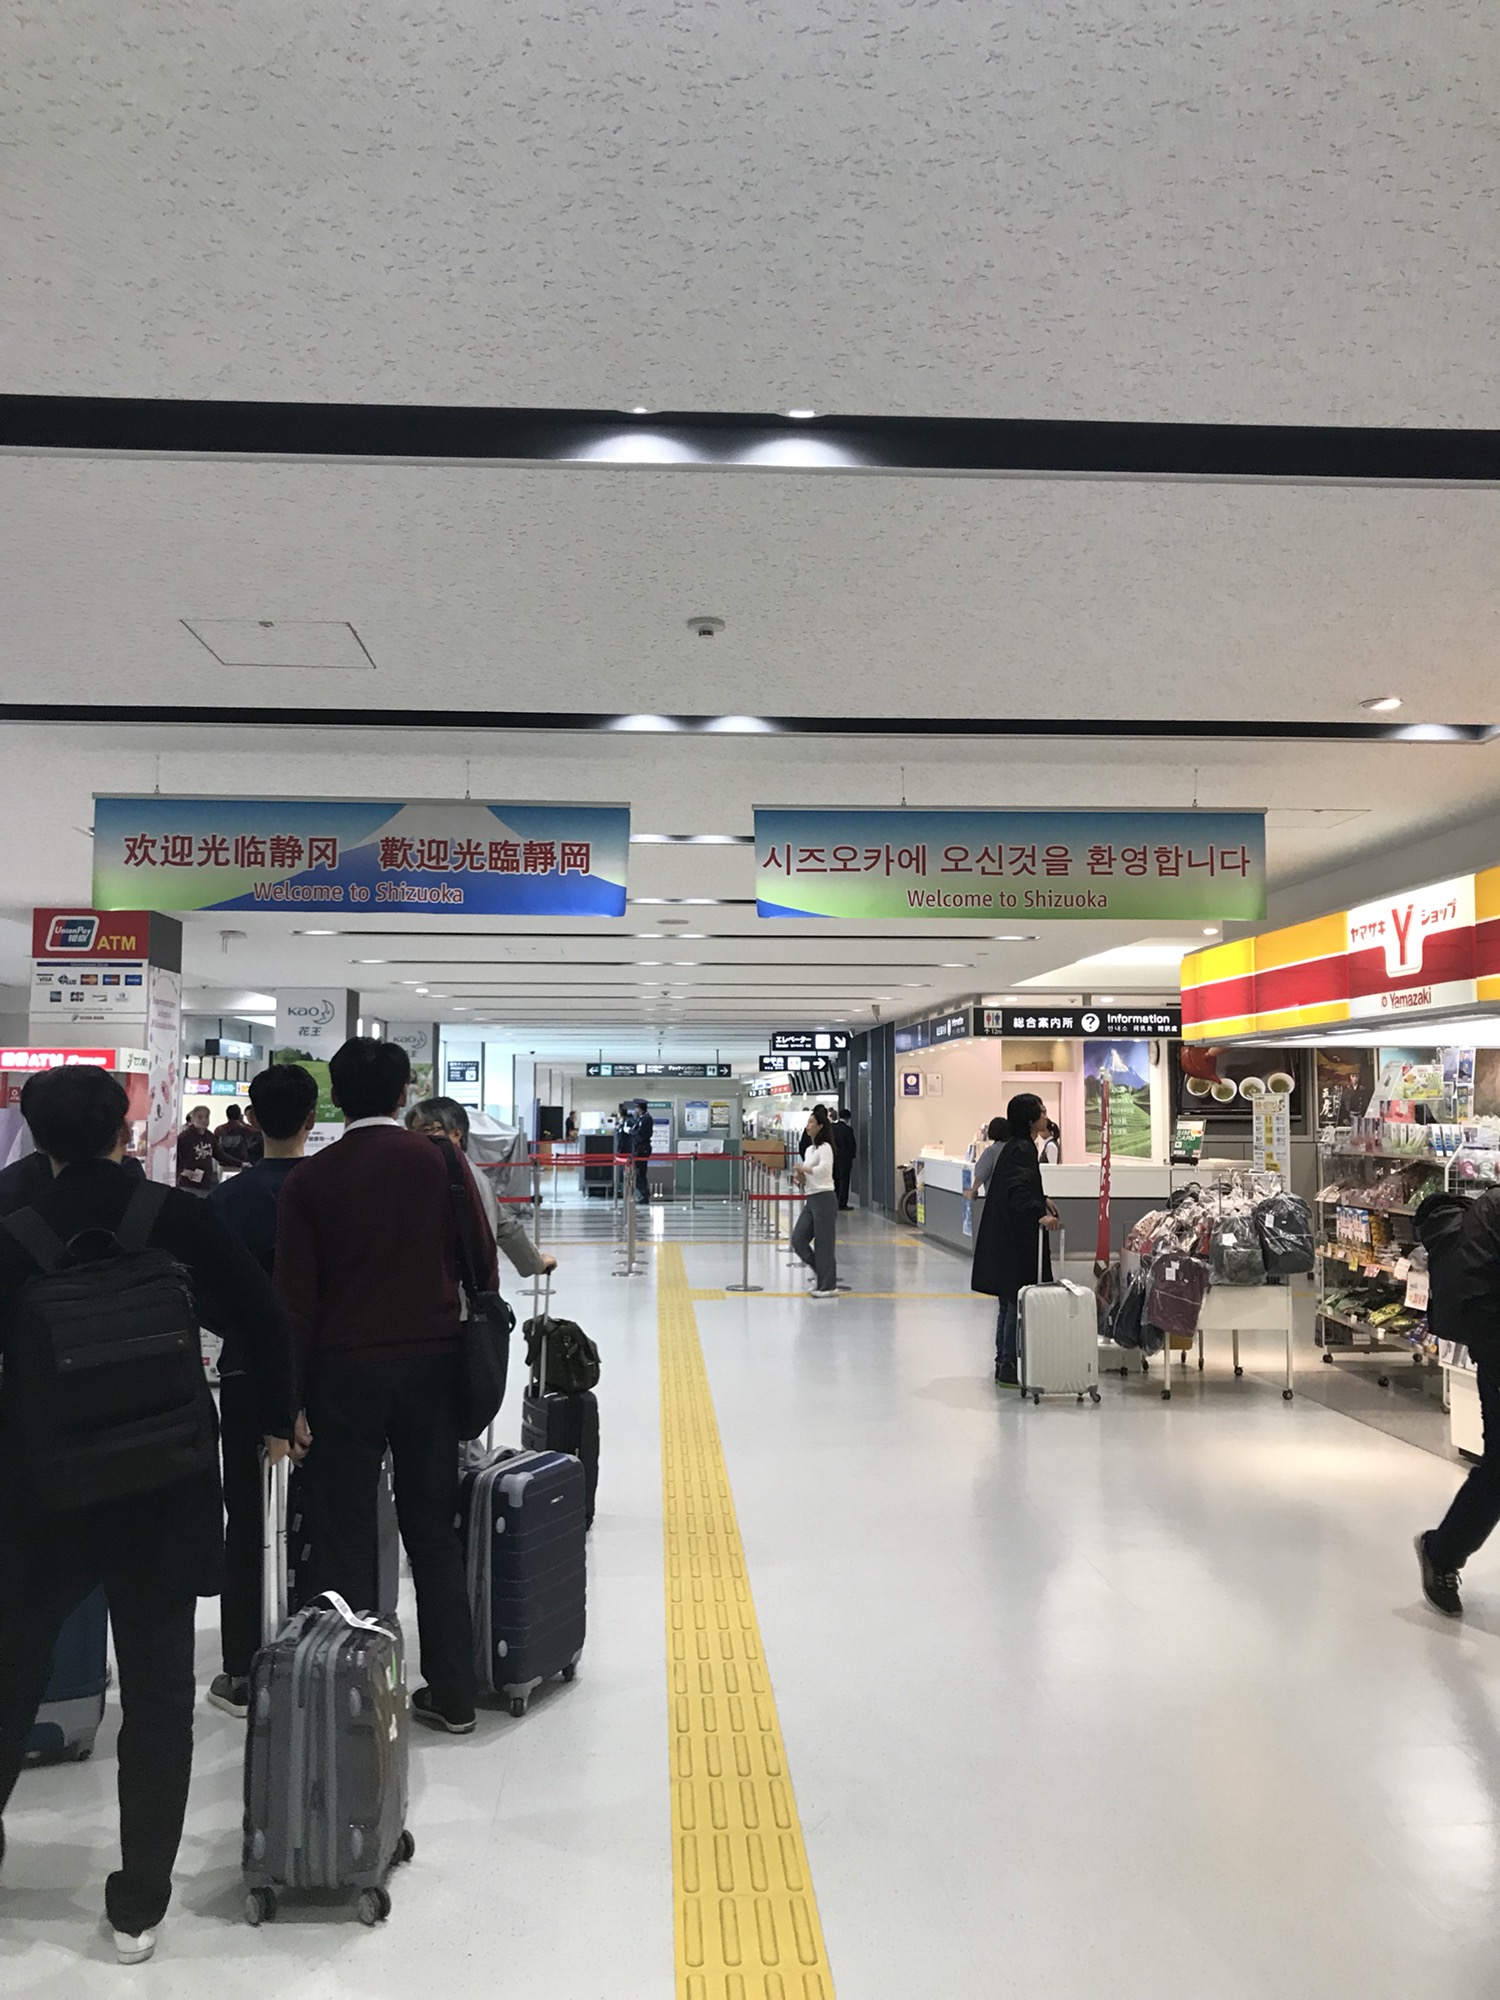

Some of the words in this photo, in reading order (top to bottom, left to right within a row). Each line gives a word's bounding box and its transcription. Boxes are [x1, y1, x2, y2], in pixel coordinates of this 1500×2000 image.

[123, 833, 338, 869] 欢迎光临静冈
[379, 836, 592, 876] 歡迎光臨靜岡
[762, 843, 927, 877] 시즈오카에
[940, 843, 1073, 877] 오신것을
[1086, 844, 1251, 877] 환영합니다
[253, 881, 343, 902] Welcome
[349, 884, 370, 902] to
[375, 882, 464, 904] Shizuoka
[907, 889, 993, 908] Welcome
[999, 892, 1017, 908] to
[1023, 889, 1108, 909] Shizuoka
[1421, 898, 1457, 926] ショップ
[55, 926, 92, 938] UnionPay
[97, 935, 136, 950] ATM
[1391, 903, 1415, 966] Y
[1389, 987, 1432, 1009] Yamazaki
[1013, 1017, 1074, 1029] 総合案内所
[1107, 1013, 1170, 1024] Information
[298, 1026, 322, 1037] 花王
